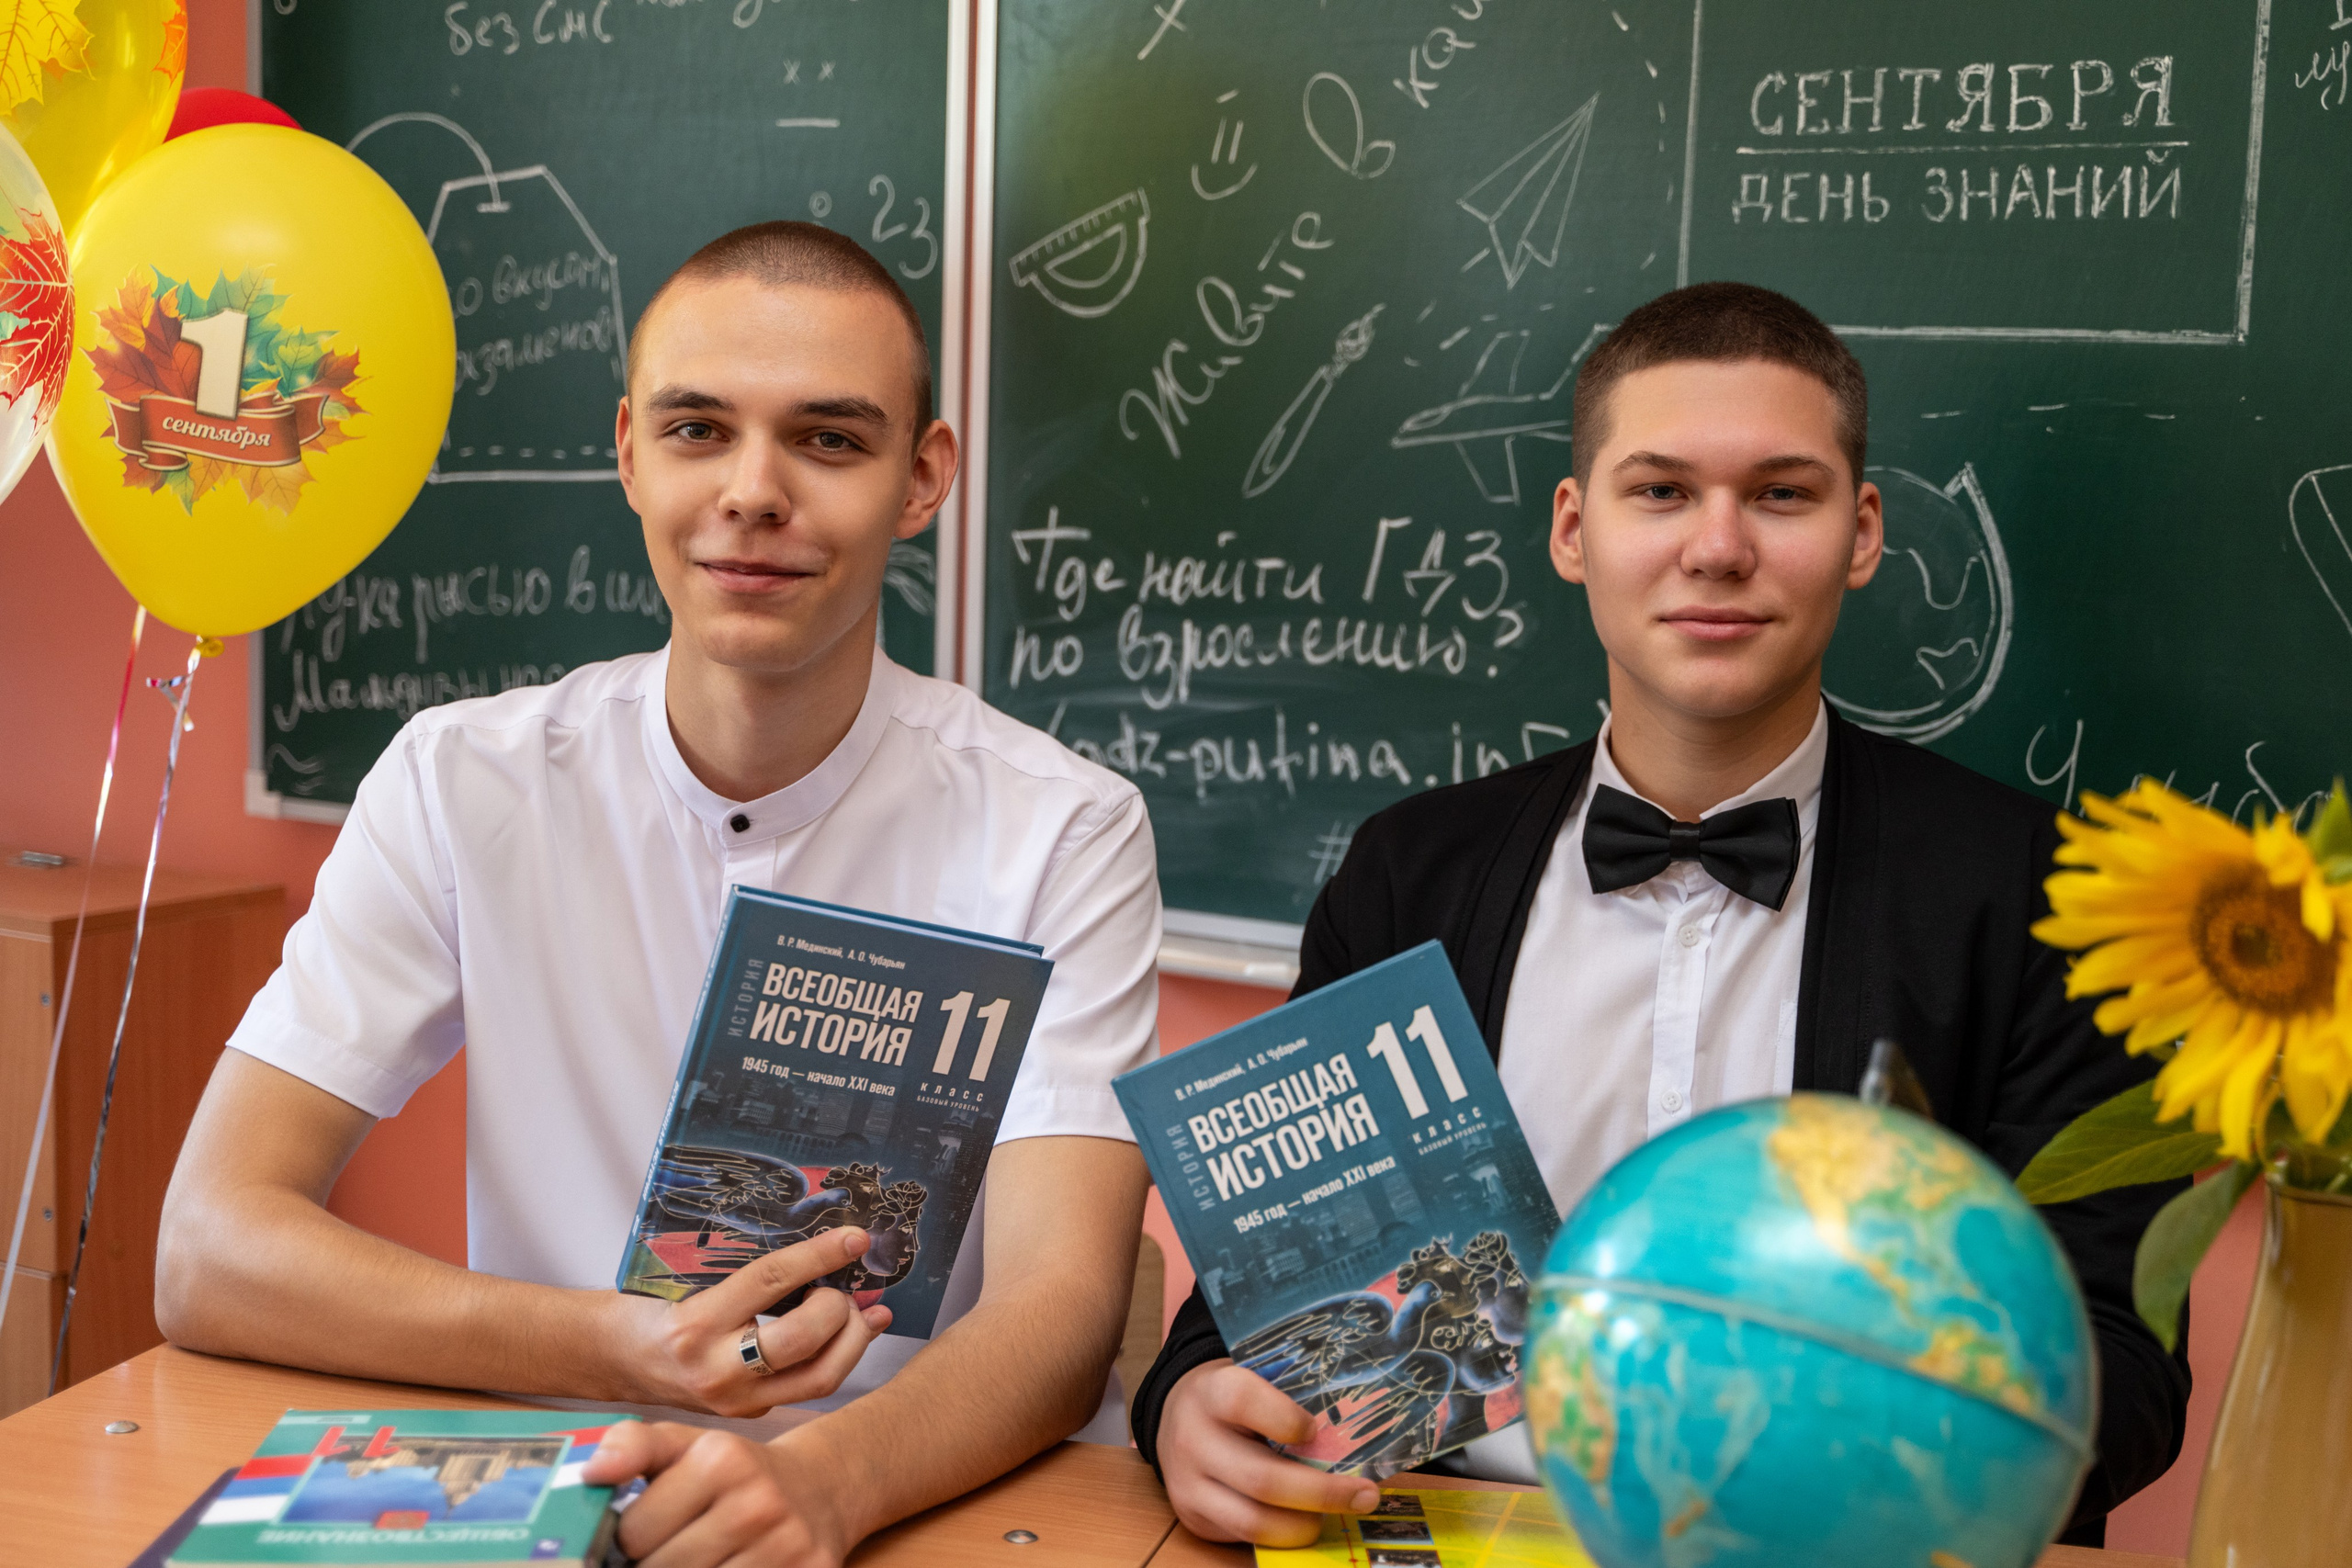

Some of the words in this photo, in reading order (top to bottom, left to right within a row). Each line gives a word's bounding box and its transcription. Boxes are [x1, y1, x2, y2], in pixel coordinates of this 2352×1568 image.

[1749, 55, 2175, 137] СЕНТЯБРЯ
[1732, 171, 1891, 224] ДЕНЬ
[1920, 148, 2182, 223] ЗНАНИЙ
[180, 308, 249, 421] 1
[162, 415, 272, 450] сентября
[1138, 530, 1325, 604] найти
[1362, 516, 1510, 621] ГДЗ
[1010, 625, 1083, 690] по
[796, 938, 844, 959] Мединский,
[847, 949, 856, 960] А.
[868, 953, 906, 970] Чубарьян
[728, 958, 764, 1037] ИСТОРИЯ
[749, 1000, 912, 1066] ИСТОРИЯ
[762, 963, 924, 1023] ВСЕОБЩАЯ
[932, 990, 1011, 1082] 11
[741, 1056, 769, 1073] 1945
[769, 1064, 790, 1078] год
[807, 1069, 846, 1088] начало
[847, 1076, 869, 1091] XXI
[869, 1082, 896, 1097] века
[1187, 1053, 1358, 1154] ВСЕОБЩАЯ
[1366, 1004, 1468, 1120] 11
[1266, 1036, 1309, 1061] Чубарьян
[1165, 1123, 1216, 1212] ИСТОРИЯ
[1205, 1092, 1380, 1201] ИСТОРИЯ
[1233, 1208, 1264, 1234] 1945
[1264, 1203, 1288, 1223] год
[1301, 1179, 1344, 1205] начало
[1342, 1165, 1367, 1187] XXI
[1366, 1156, 1396, 1178] века
